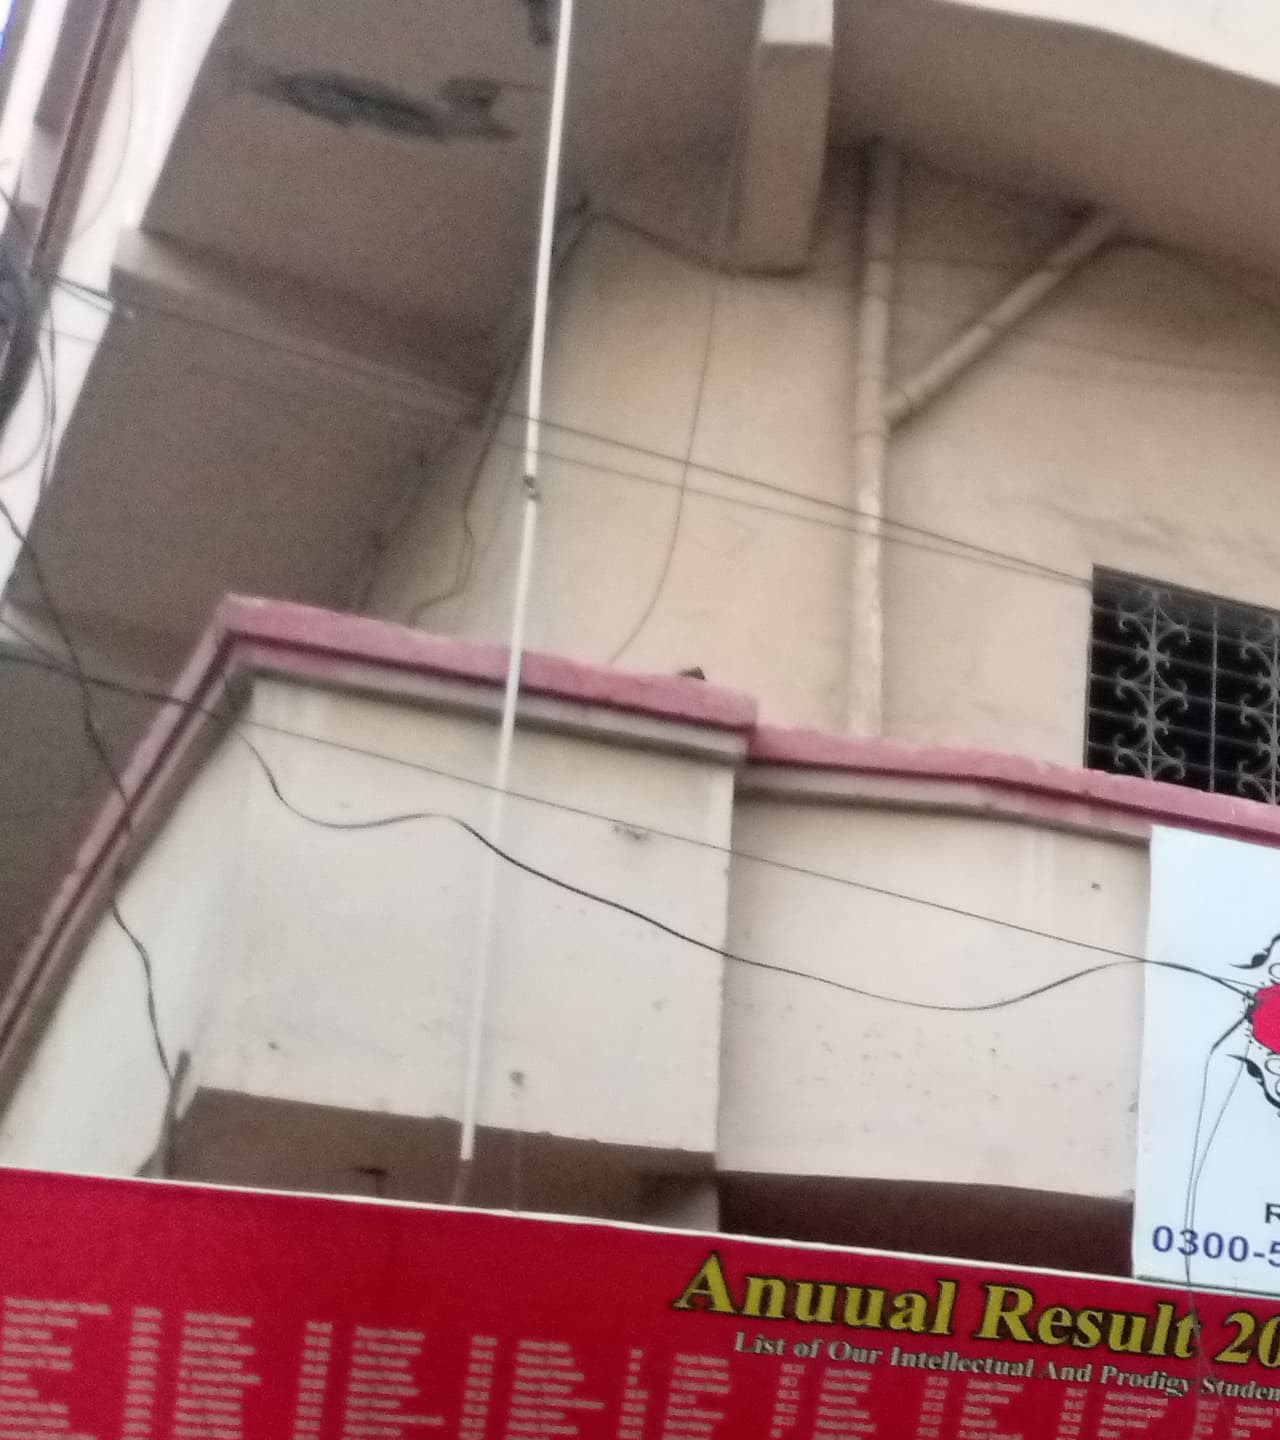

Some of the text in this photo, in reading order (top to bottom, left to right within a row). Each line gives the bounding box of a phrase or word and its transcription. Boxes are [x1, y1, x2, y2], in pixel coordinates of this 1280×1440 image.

[671, 1250, 959, 1335] Anuual
[973, 1282, 1200, 1360] Result
[735, 1332, 786, 1357] List
[794, 1338, 823, 1359] of
[828, 1340, 883, 1365] Our
[890, 1347, 1034, 1378] Intellectual
[1039, 1360, 1092, 1383] And
[1100, 1365, 1192, 1397] Prodigy
